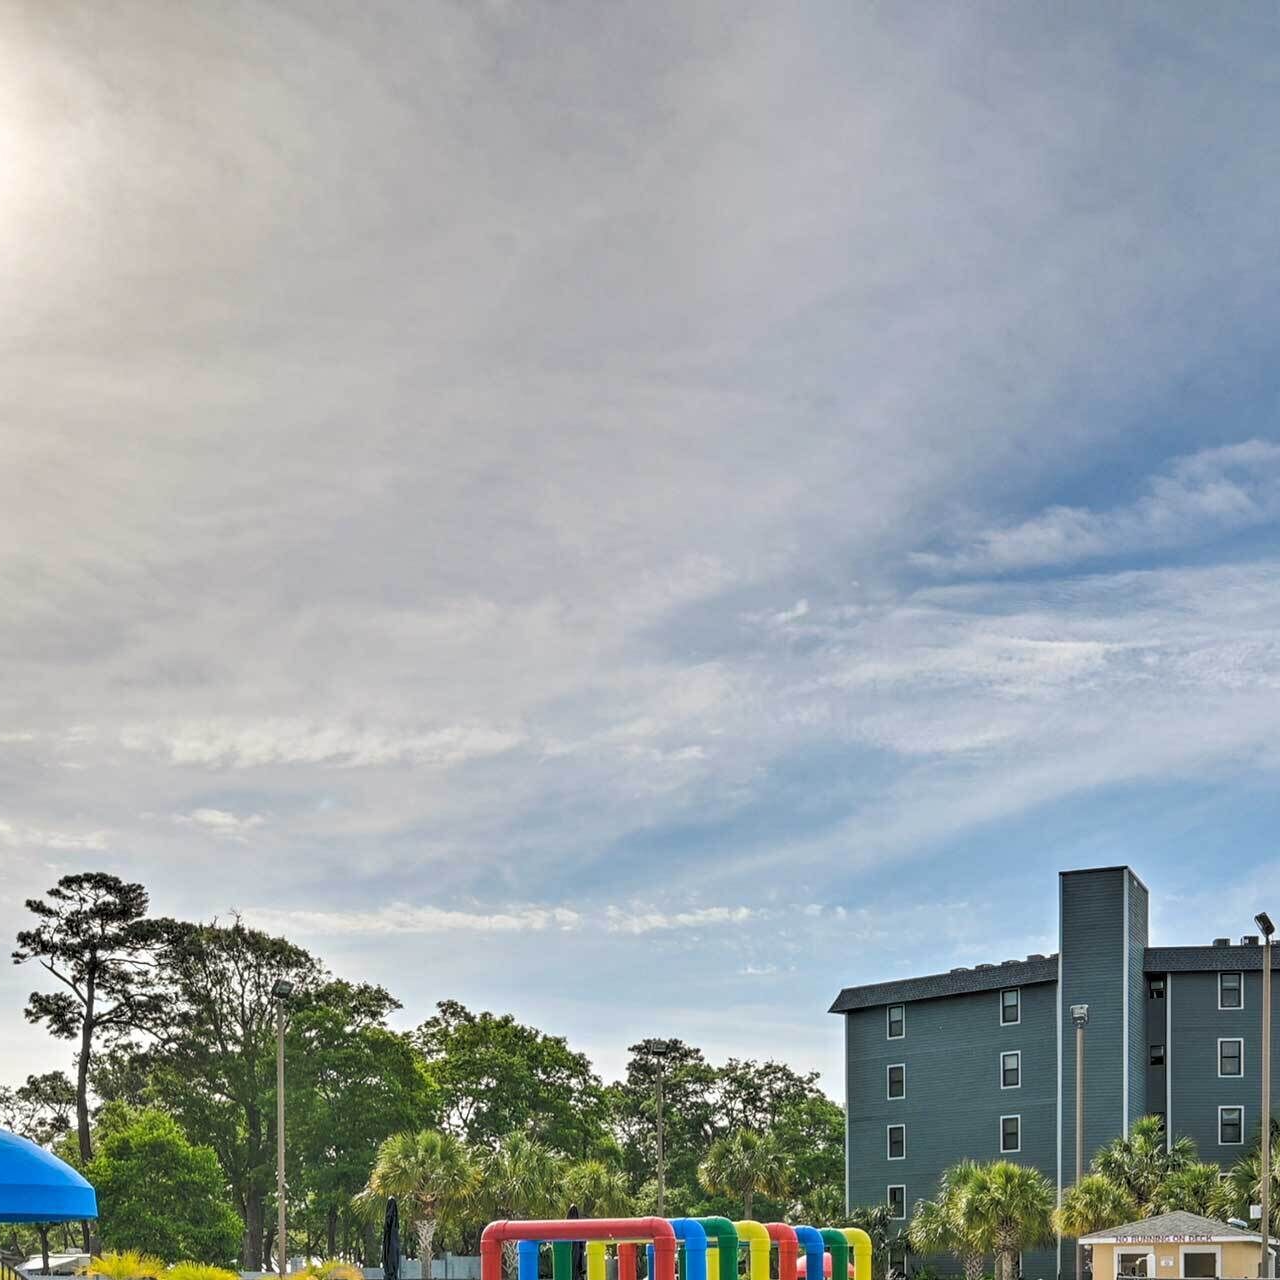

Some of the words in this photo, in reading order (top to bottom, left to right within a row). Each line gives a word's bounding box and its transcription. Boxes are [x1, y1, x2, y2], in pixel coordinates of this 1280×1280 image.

[1115, 1235, 1129, 1244] NO
[1131, 1235, 1171, 1244] RUNNING
[1173, 1234, 1185, 1243] ON
[1188, 1234, 1213, 1243] DECK
